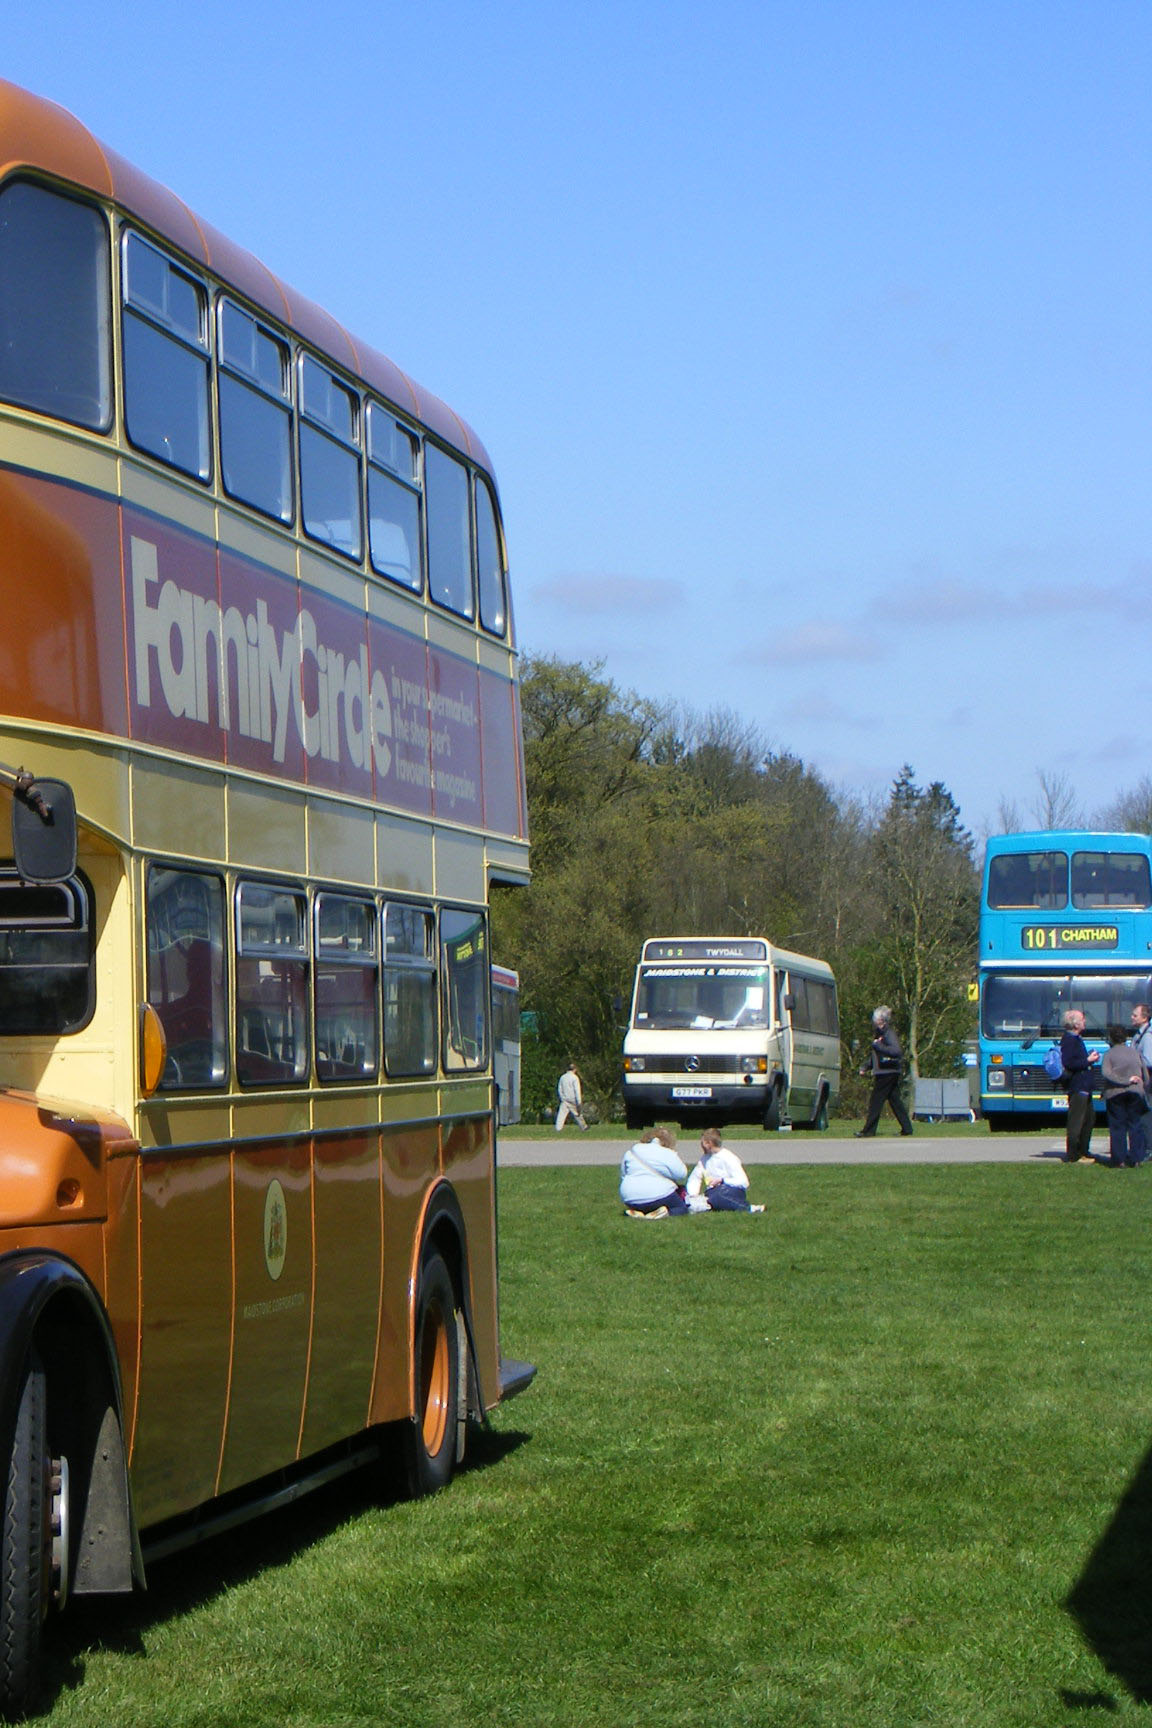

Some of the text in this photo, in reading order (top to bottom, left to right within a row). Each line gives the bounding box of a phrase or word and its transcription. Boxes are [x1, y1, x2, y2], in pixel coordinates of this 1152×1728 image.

[1061, 928, 1117, 941] CHATHAM
[705, 948, 744, 956] TWYDALL
[643, 967, 766, 977] MAIDSTONE & DISTRICT
